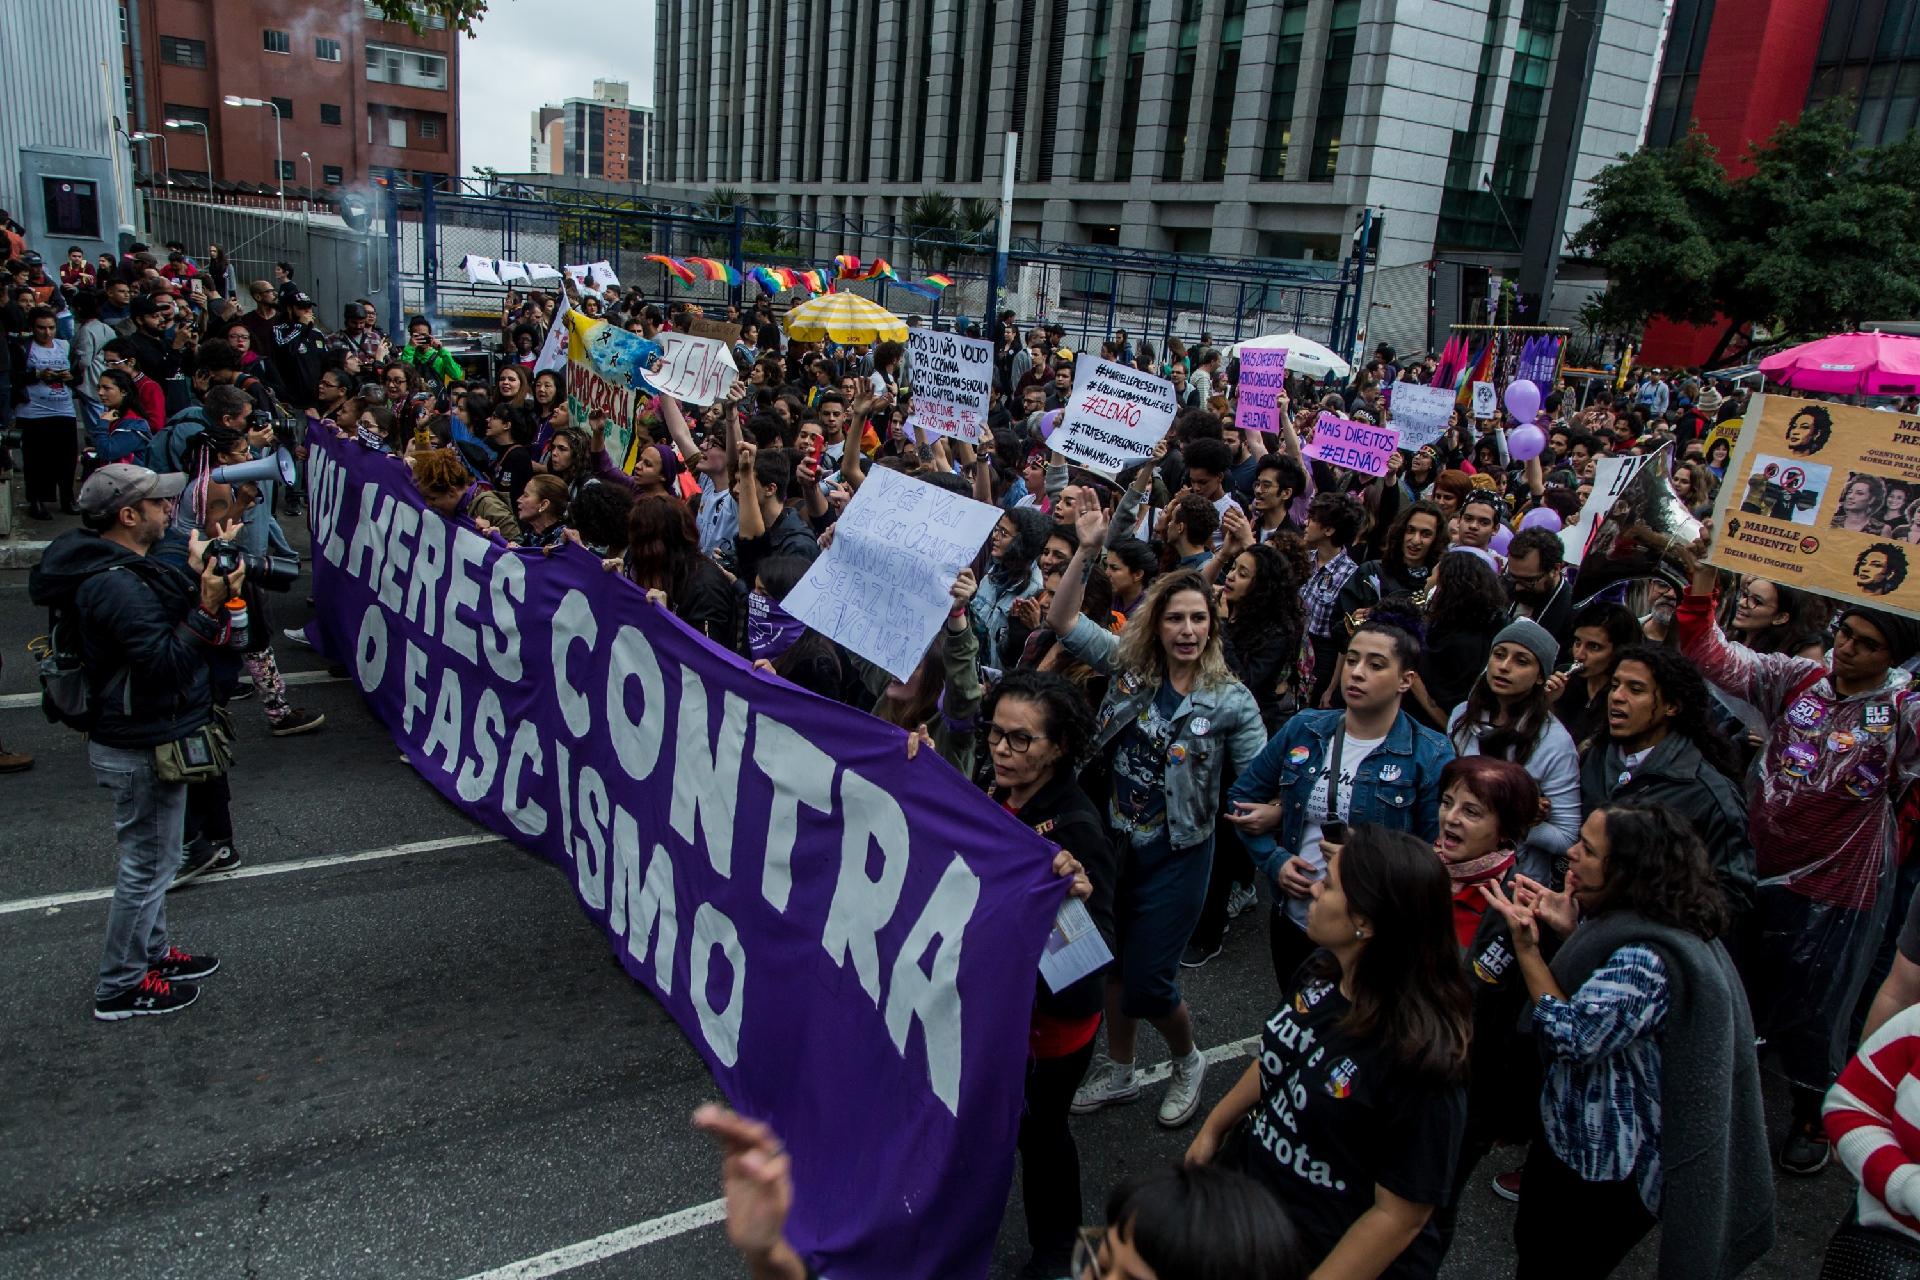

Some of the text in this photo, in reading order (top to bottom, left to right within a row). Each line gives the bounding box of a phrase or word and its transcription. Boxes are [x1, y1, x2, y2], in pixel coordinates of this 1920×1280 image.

[909, 333, 988, 364] POIS EU NÃO VOLTO
[1241, 352, 1257, 367] MAIS
[915, 352, 959, 373] PRA COZINHA
[912, 384, 925, 398] NEM
[926, 385, 931, 397] O
[932, 387, 943, 400] GAY
[913, 369, 926, 384] NEM
[928, 372, 933, 385] O
[961, 378, 989, 395] SENZALA
[1082, 394, 1141, 428] #ELENÃO
[1317, 421, 1395, 452] MAIS DIREITOS
[1892, 433, 1920, 446] PRE
[1319, 443, 1382, 473] #ELENÃO
[928, 489, 965, 528] VAI
[1739, 532, 1797, 554] PRESENTE!
[1744, 521, 1800, 541] MARIELLE
[307, 442, 526, 682] MULHERES
[1724, 547, 1803, 573] IDEIAS SÃO IMORTAIS
[356, 604, 388, 693] O
[1866, 706, 1889, 717] ELE
[1866, 715, 1889, 724] NÃO
[403, 639, 746, 1068] FASCISMO
[551, 588, 981, 1118] CONTRA
[1487, 941, 1514, 968] ELE
[1266, 1003, 1325, 1068] Lute
